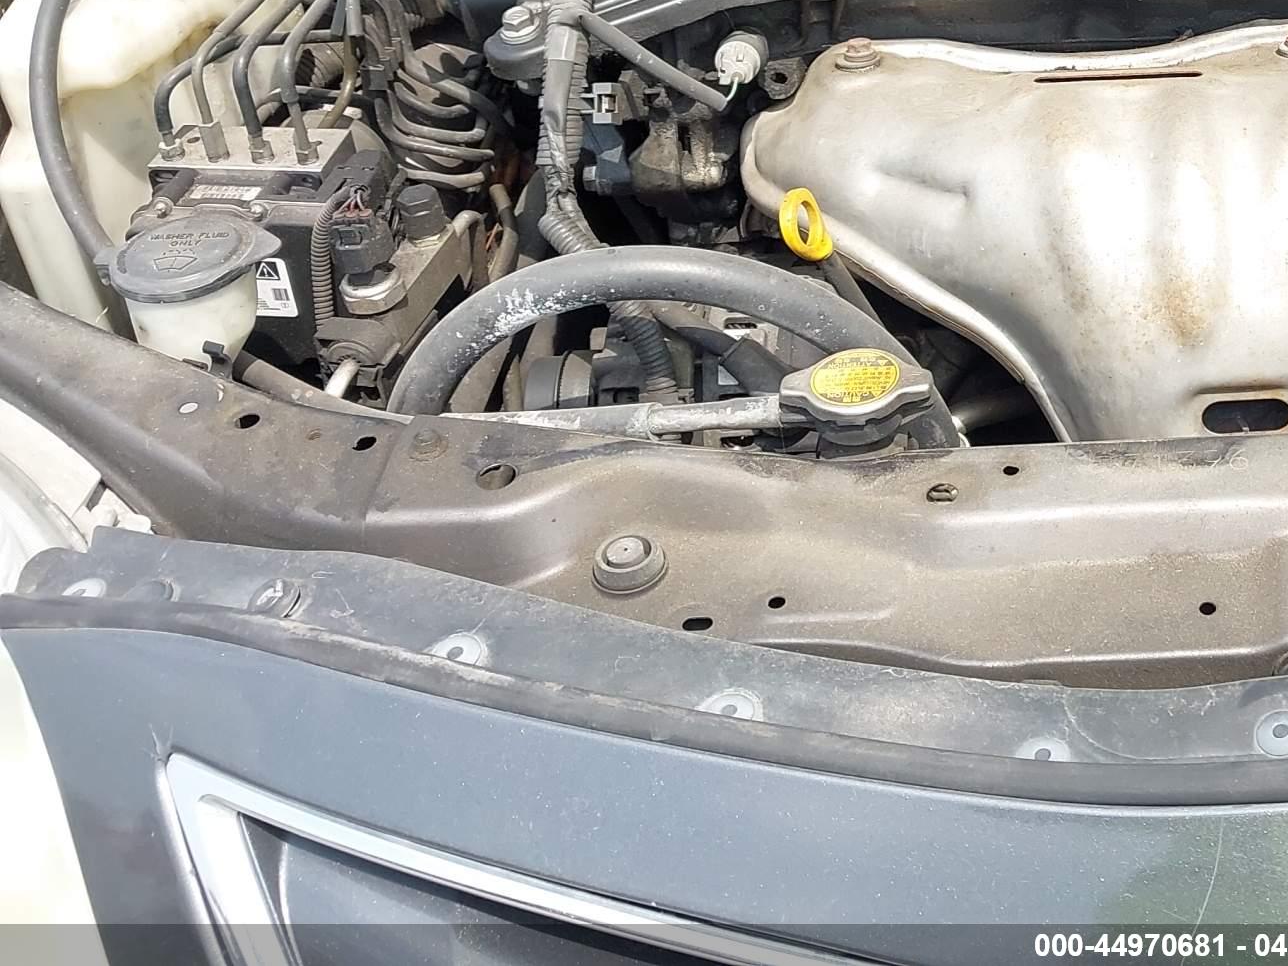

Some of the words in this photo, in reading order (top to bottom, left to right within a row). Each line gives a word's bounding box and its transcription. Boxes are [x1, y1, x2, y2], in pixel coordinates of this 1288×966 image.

[150, 232, 195, 241] WASHER
[198, 231, 231, 240] FLUID
[169, 239, 202, 247] ONLY
